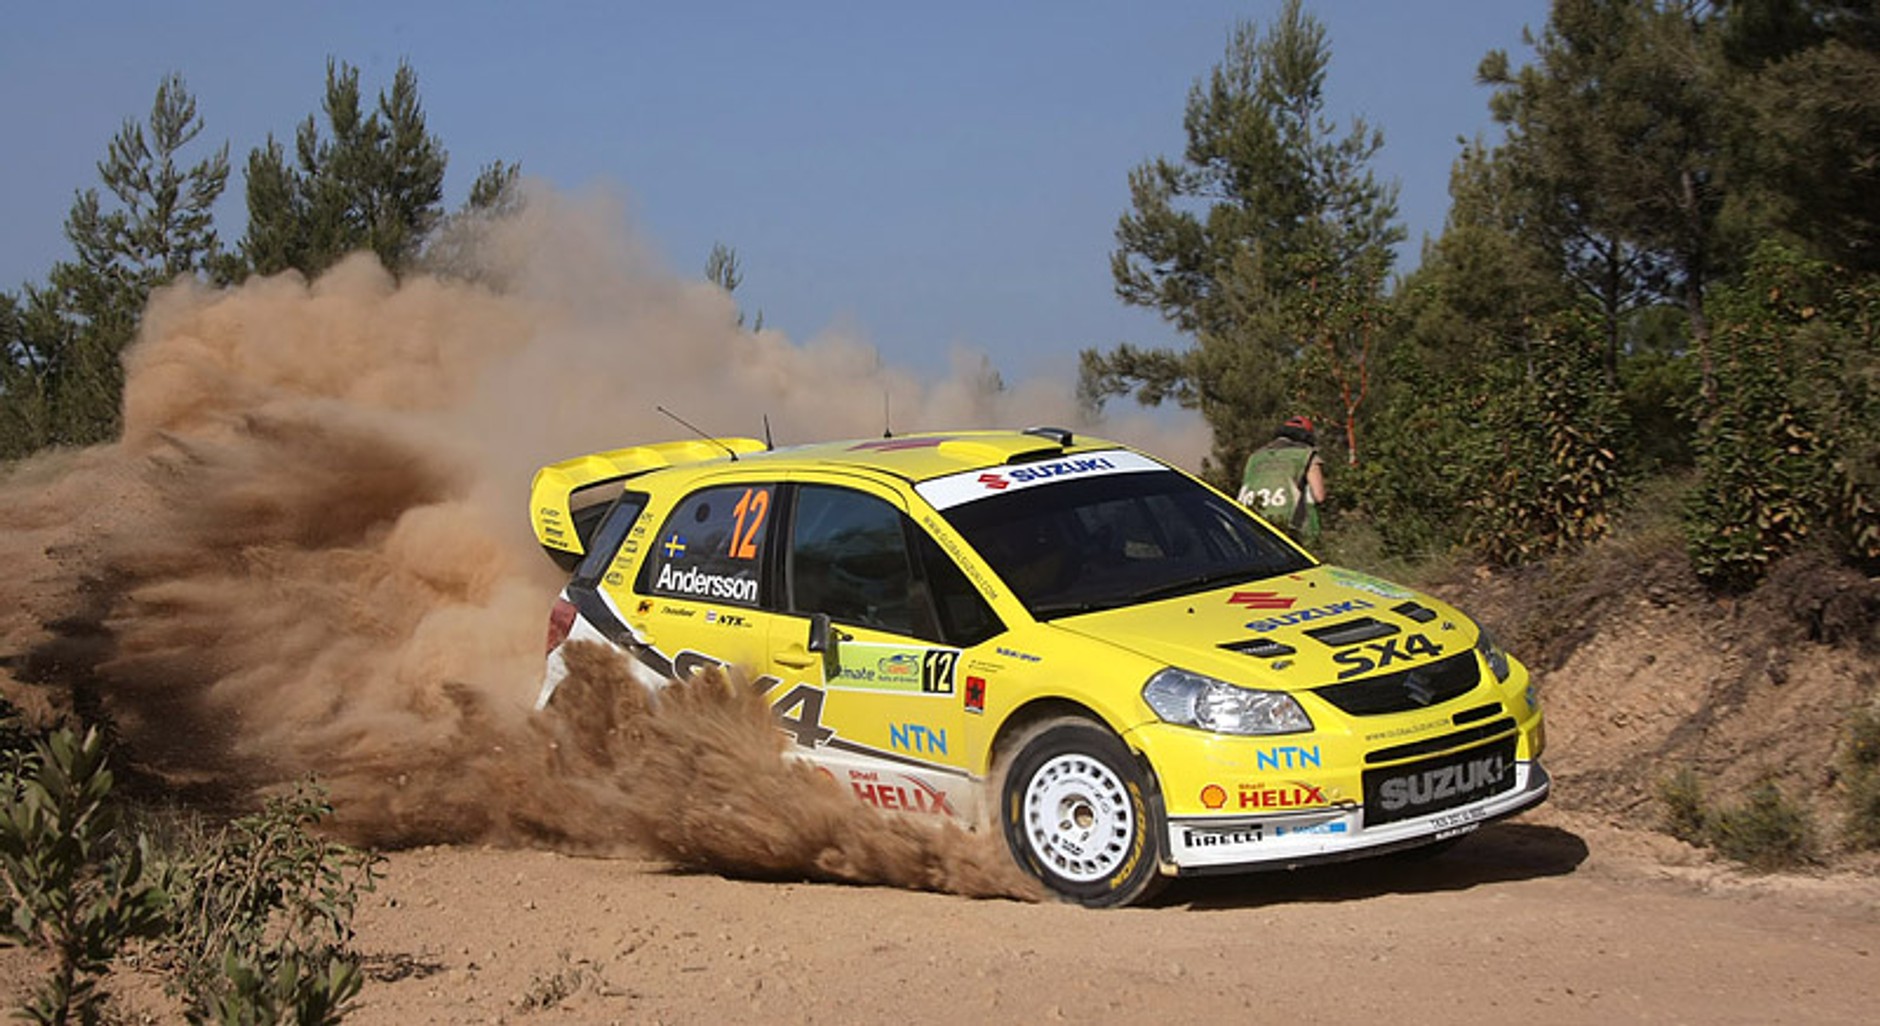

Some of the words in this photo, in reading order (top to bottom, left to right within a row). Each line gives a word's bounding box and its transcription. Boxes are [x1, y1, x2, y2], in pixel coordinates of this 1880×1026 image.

[1009, 458, 1115, 482] SUZUKI
[728, 488, 769, 558] 12
[656, 563, 758, 601] Andersson
[1244, 600, 1374, 632] SUZUKI
[926, 653, 953, 692] 12
[1332, 633, 1443, 680] SX4
[890, 723, 948, 755] NTN
[1257, 745, 1321, 770] NTN
[849, 769, 878, 781] Shell
[1380, 756, 1503, 810] SUZUKI
[851, 775, 956, 816] HELIX
[1239, 782, 1327, 808] HELIX
[1183, 824, 1262, 848] PIRELLI
